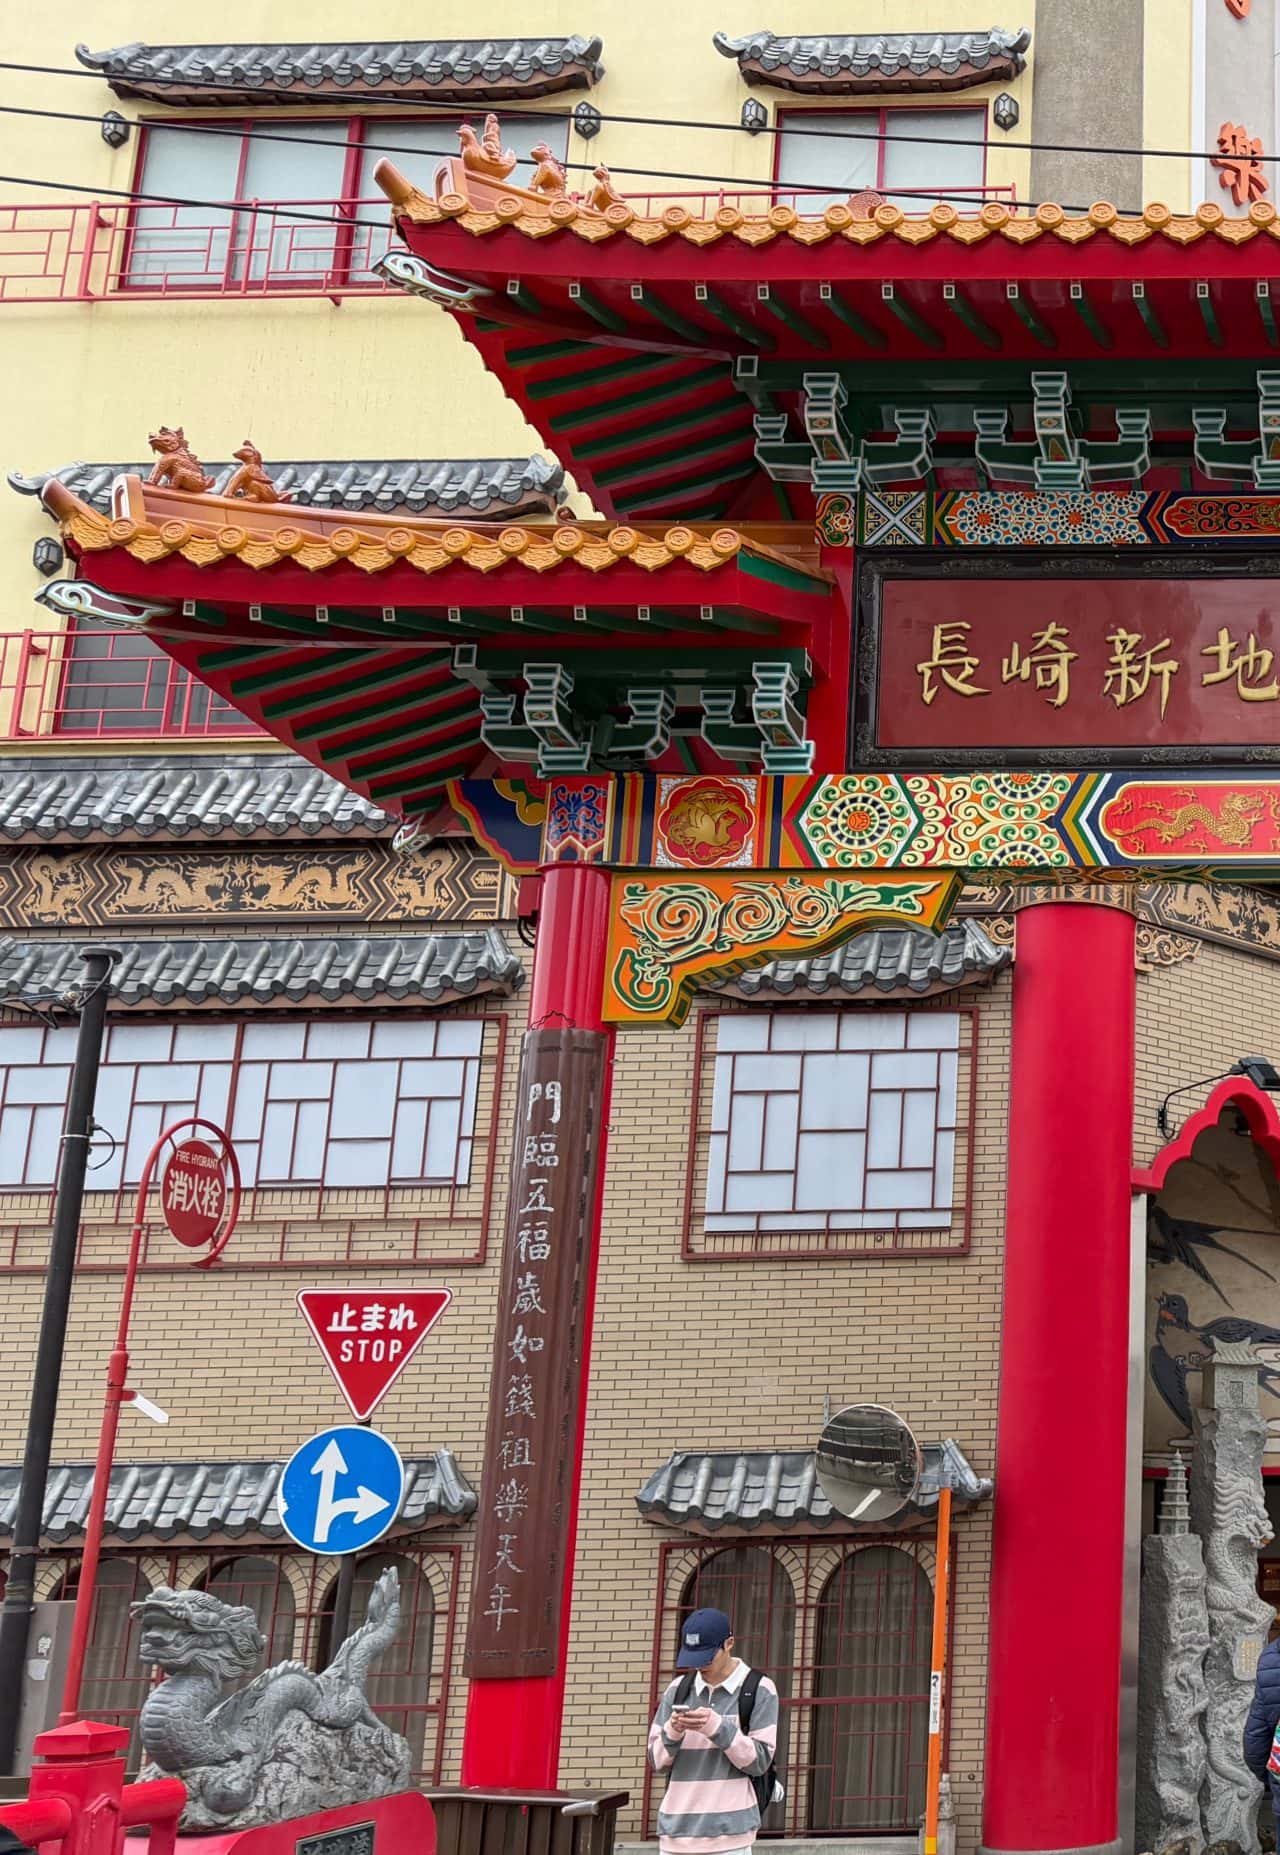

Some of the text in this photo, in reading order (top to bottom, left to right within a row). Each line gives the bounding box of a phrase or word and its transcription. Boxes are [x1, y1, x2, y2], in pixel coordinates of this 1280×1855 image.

[176, 1150, 218, 1170] FIRE HYDRANT
[167, 1169, 222, 1218] 消火栓
[326, 1302, 418, 1333] 止まれ
[340, 1339, 402, 1363] STOP
